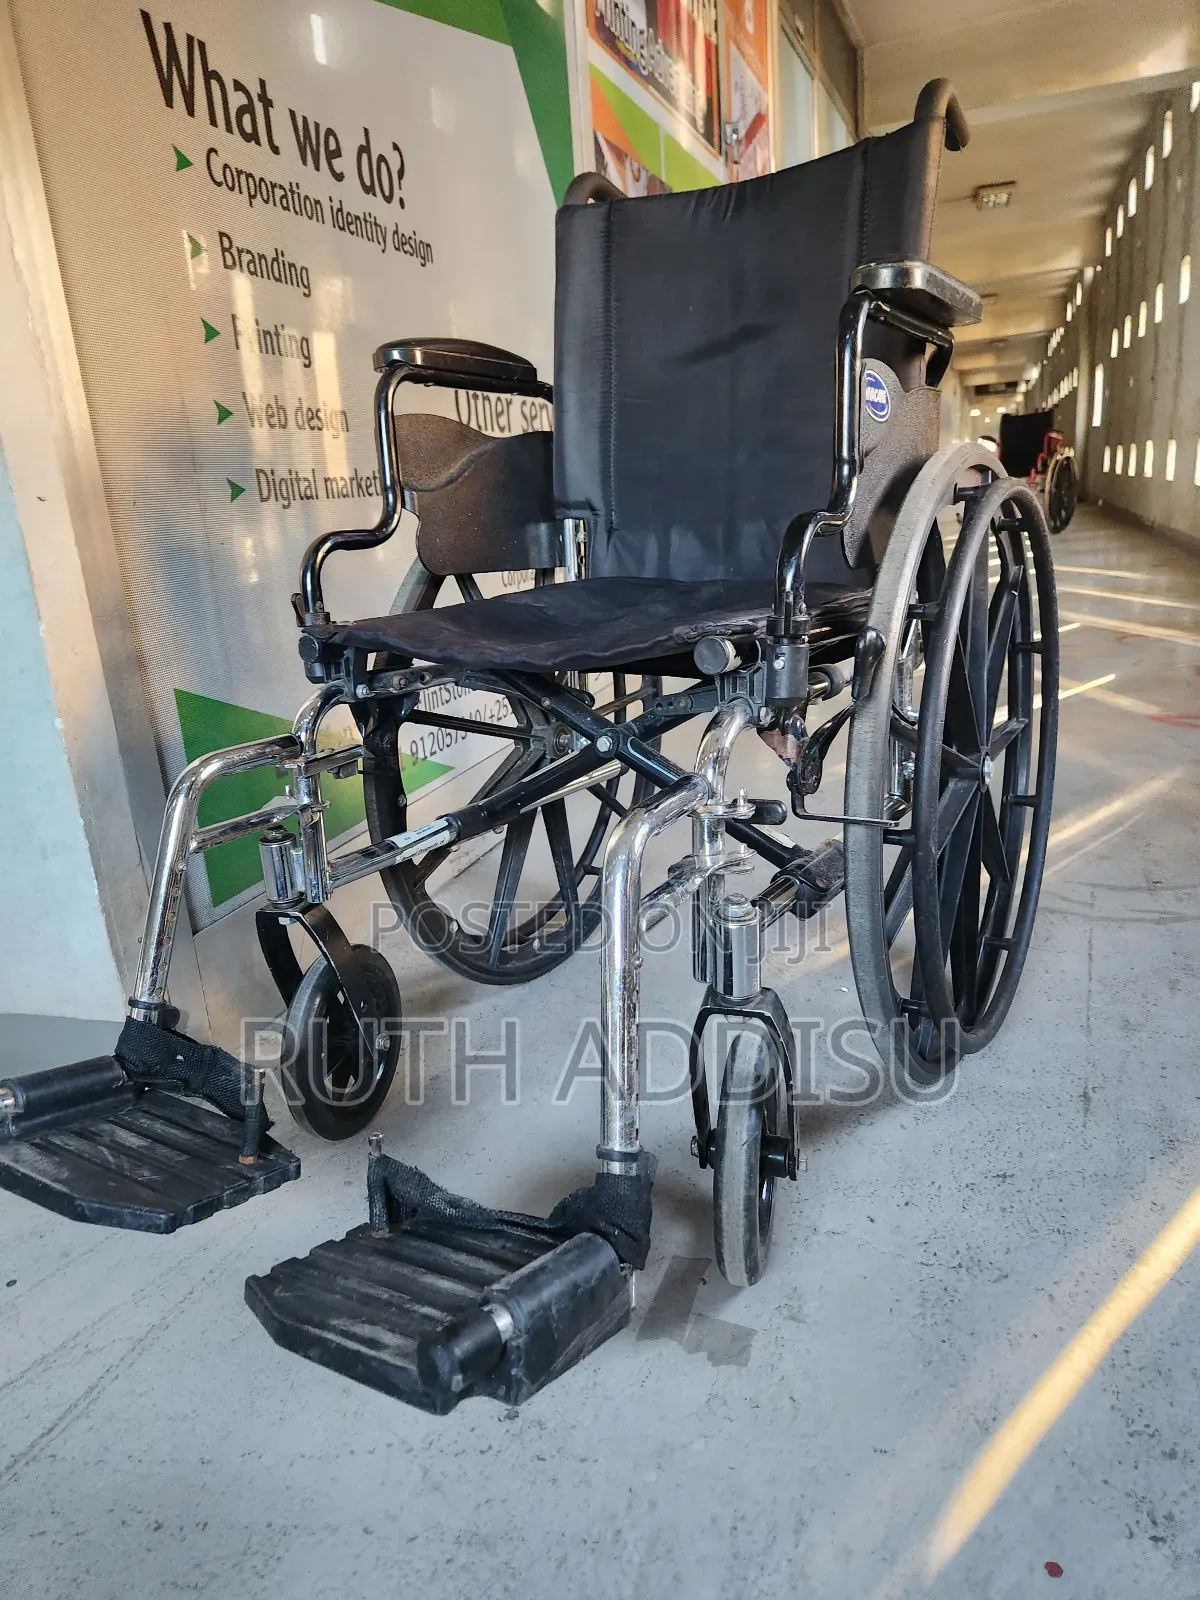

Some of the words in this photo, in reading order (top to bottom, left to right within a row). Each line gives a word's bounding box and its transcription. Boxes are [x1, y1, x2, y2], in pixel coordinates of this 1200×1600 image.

[139, 8, 281, 156] What
[288, 107, 345, 183] we
[356, 126, 406, 210] do?
[206, 147, 326, 225] Corporation
[329, 196, 387, 254] identity
[392, 222, 434, 268] design
[217, 230, 312, 298] Branding
[231, 313, 312, 369] Pinting
[242, 391, 288, 430] Web
[294, 397, 350, 440] design
[255, 468, 319, 510] Digital
